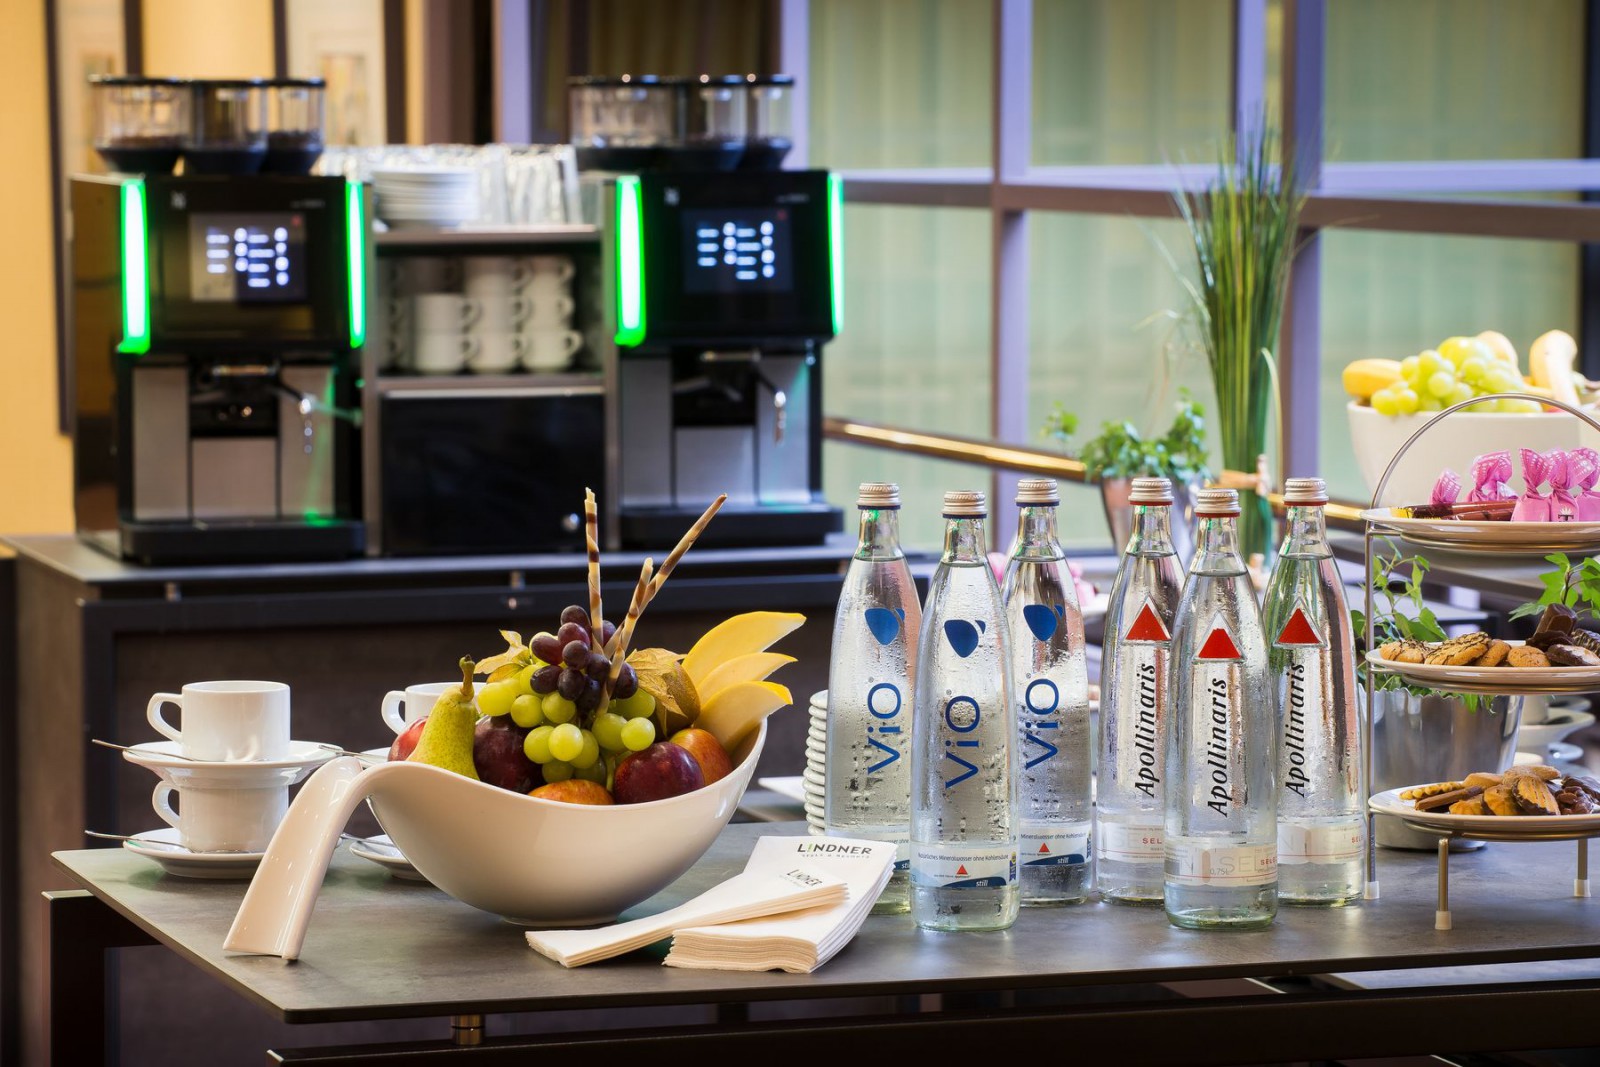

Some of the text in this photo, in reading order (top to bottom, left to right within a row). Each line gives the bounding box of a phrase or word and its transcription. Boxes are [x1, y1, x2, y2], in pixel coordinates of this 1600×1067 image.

[1134, 663, 1160, 799] Apollinaris
[1207, 677, 1233, 818] Apollinaris
[1285, 662, 1310, 798] Apollinaris
[797, 843, 873, 855] LINDNER
[975, 879, 989, 887] still
[1057, 856, 1070, 864] still
